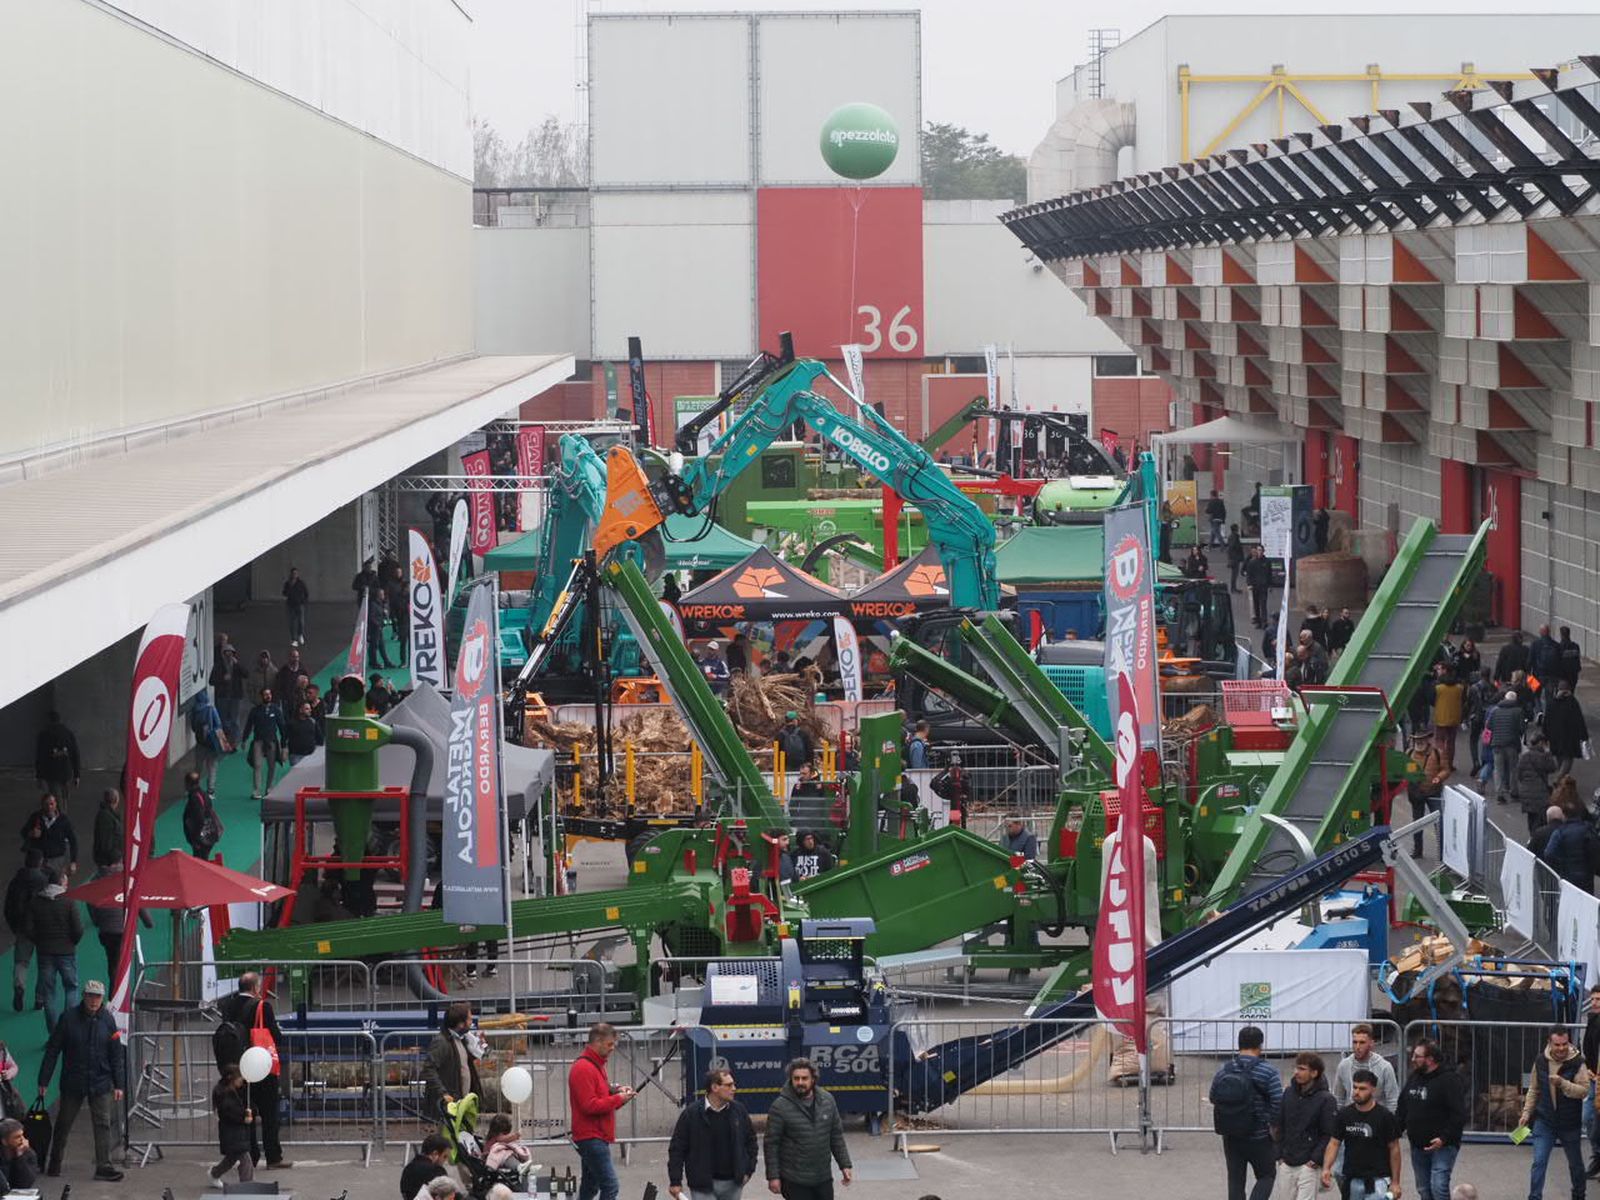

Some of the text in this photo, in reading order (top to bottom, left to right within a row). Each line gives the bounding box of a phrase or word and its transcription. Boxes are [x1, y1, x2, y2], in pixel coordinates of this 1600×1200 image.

[857, 304, 918, 352] 36
[830, 424, 890, 472] KOBELCO
[680, 605, 734, 619] WREKO
[771, 610, 841, 619] www.wreko.com
[851, 602, 906, 616] WREKO
[796, 855, 819, 866] JUST
[1335, 850, 1359, 866] 510
[1361, 841, 1371, 852] S
[810, 1044, 879, 1062] RCA
